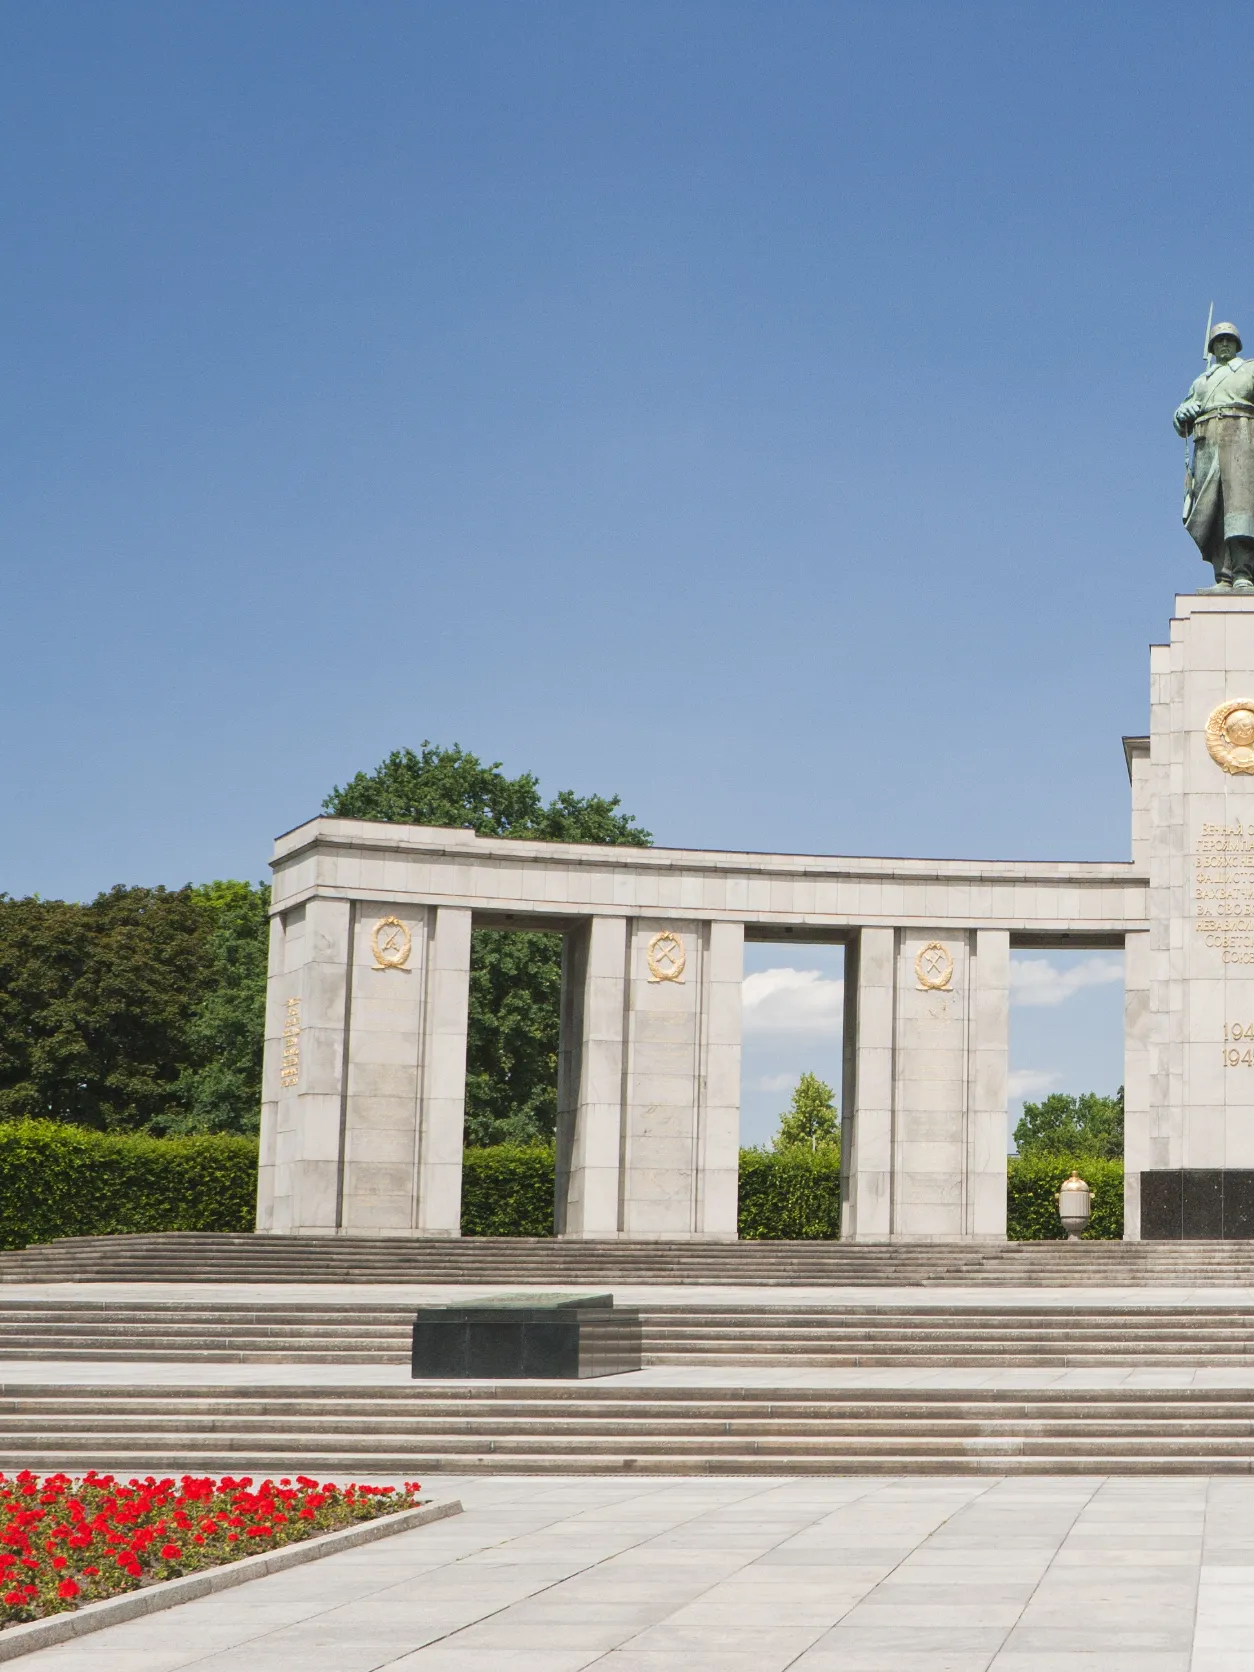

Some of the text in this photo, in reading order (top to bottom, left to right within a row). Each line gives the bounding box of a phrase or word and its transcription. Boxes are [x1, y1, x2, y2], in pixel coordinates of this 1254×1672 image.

[1201, 823, 1243, 836] ВЕЧНАЯ
[1196, 840, 1239, 852] ГЕРОЯМ
[1196, 905, 1213, 916] ЗА
